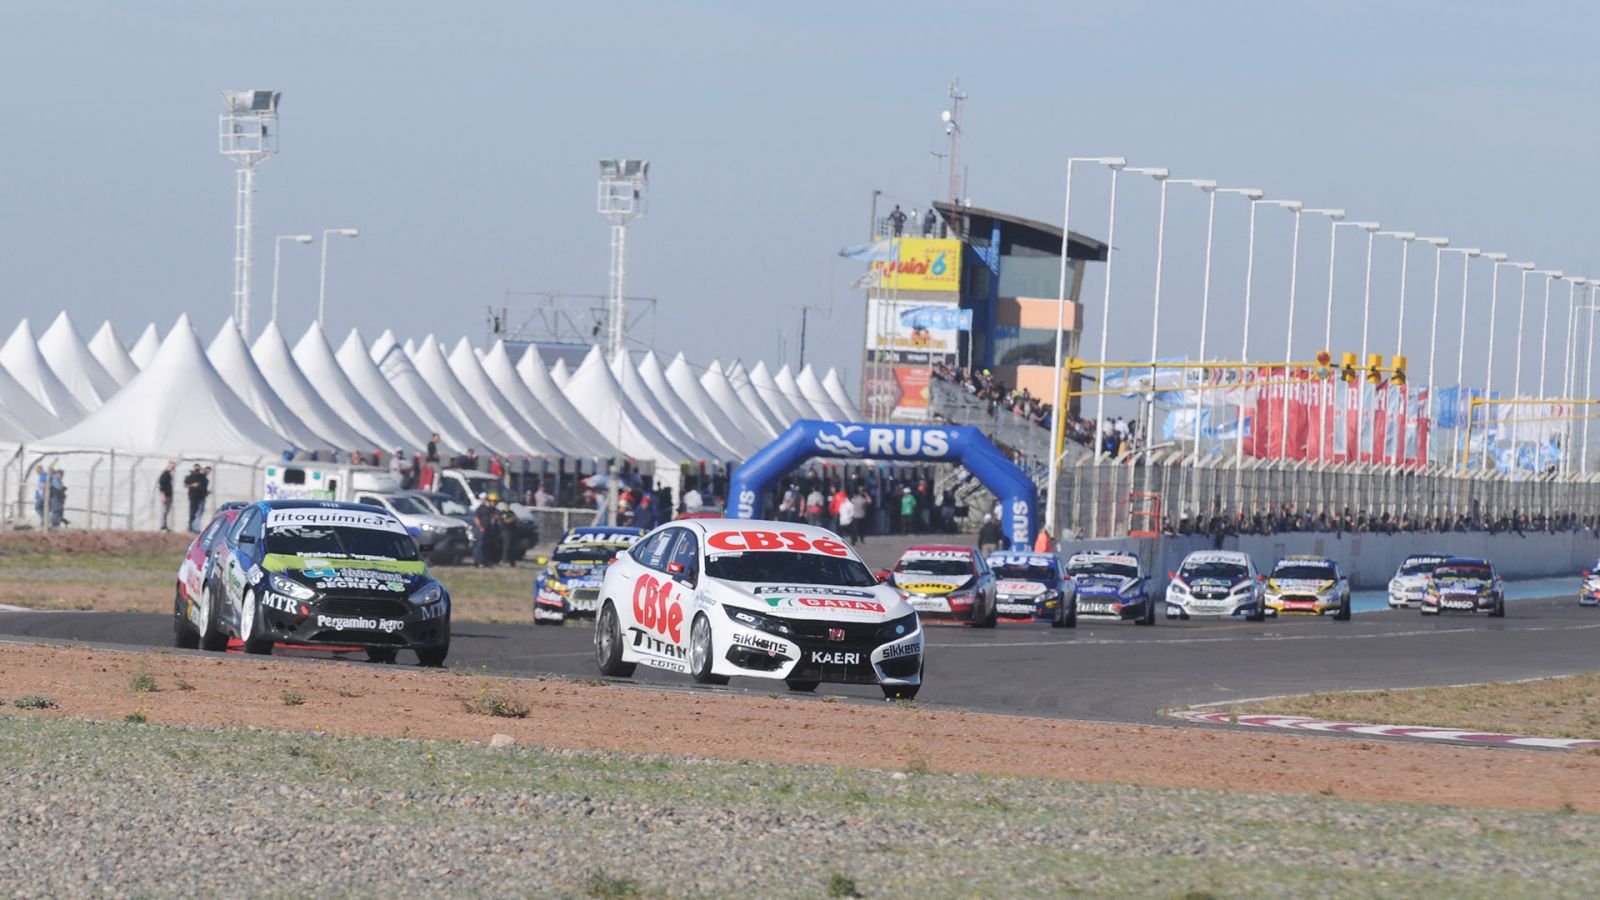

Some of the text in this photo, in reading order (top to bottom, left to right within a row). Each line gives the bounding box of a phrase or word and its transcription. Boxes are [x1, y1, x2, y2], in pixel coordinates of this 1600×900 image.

[931, 252, 946, 276] 6
[869, 428, 949, 457] RUS
[738, 490, 755, 519] US
[274, 511, 384, 527] fitoquímica
[1013, 501, 1028, 544] RUS
[707, 531, 848, 556] CBSé
[986, 556, 1049, 568] RUS
[316, 581, 389, 591] SECRETA
[262, 590, 297, 614] MTR
[633, 574, 683, 644] CBSé
[807, 599, 881, 611] GARAY
[317, 614, 404, 633] Pergamino Agro
[628, 627, 687, 659] TITAN
[732, 633, 788, 654] sikkens
[882, 642, 920, 659] sikkens
[811, 651, 860, 665] KAERI
